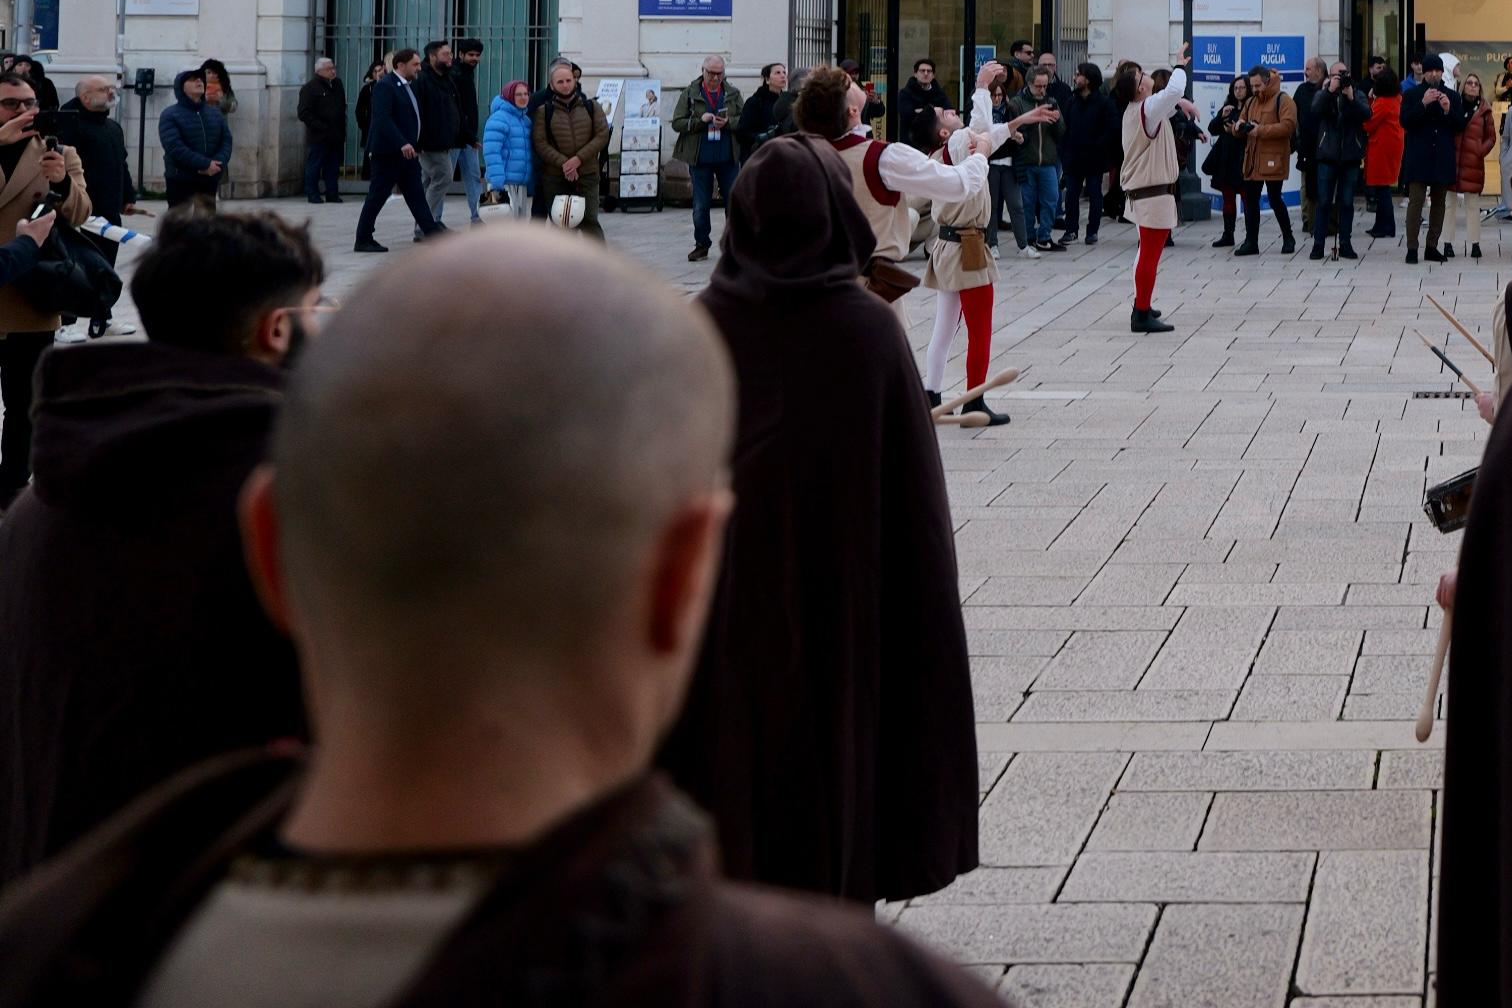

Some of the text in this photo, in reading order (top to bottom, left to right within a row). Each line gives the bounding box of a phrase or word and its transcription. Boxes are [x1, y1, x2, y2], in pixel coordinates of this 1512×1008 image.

[1207, 43, 1217, 53] BUY
[1266, 43, 1280, 53] BUY
[1203, 54, 1222, 64] PUGLIA
[1260, 54, 1286, 64] PUGLIA
